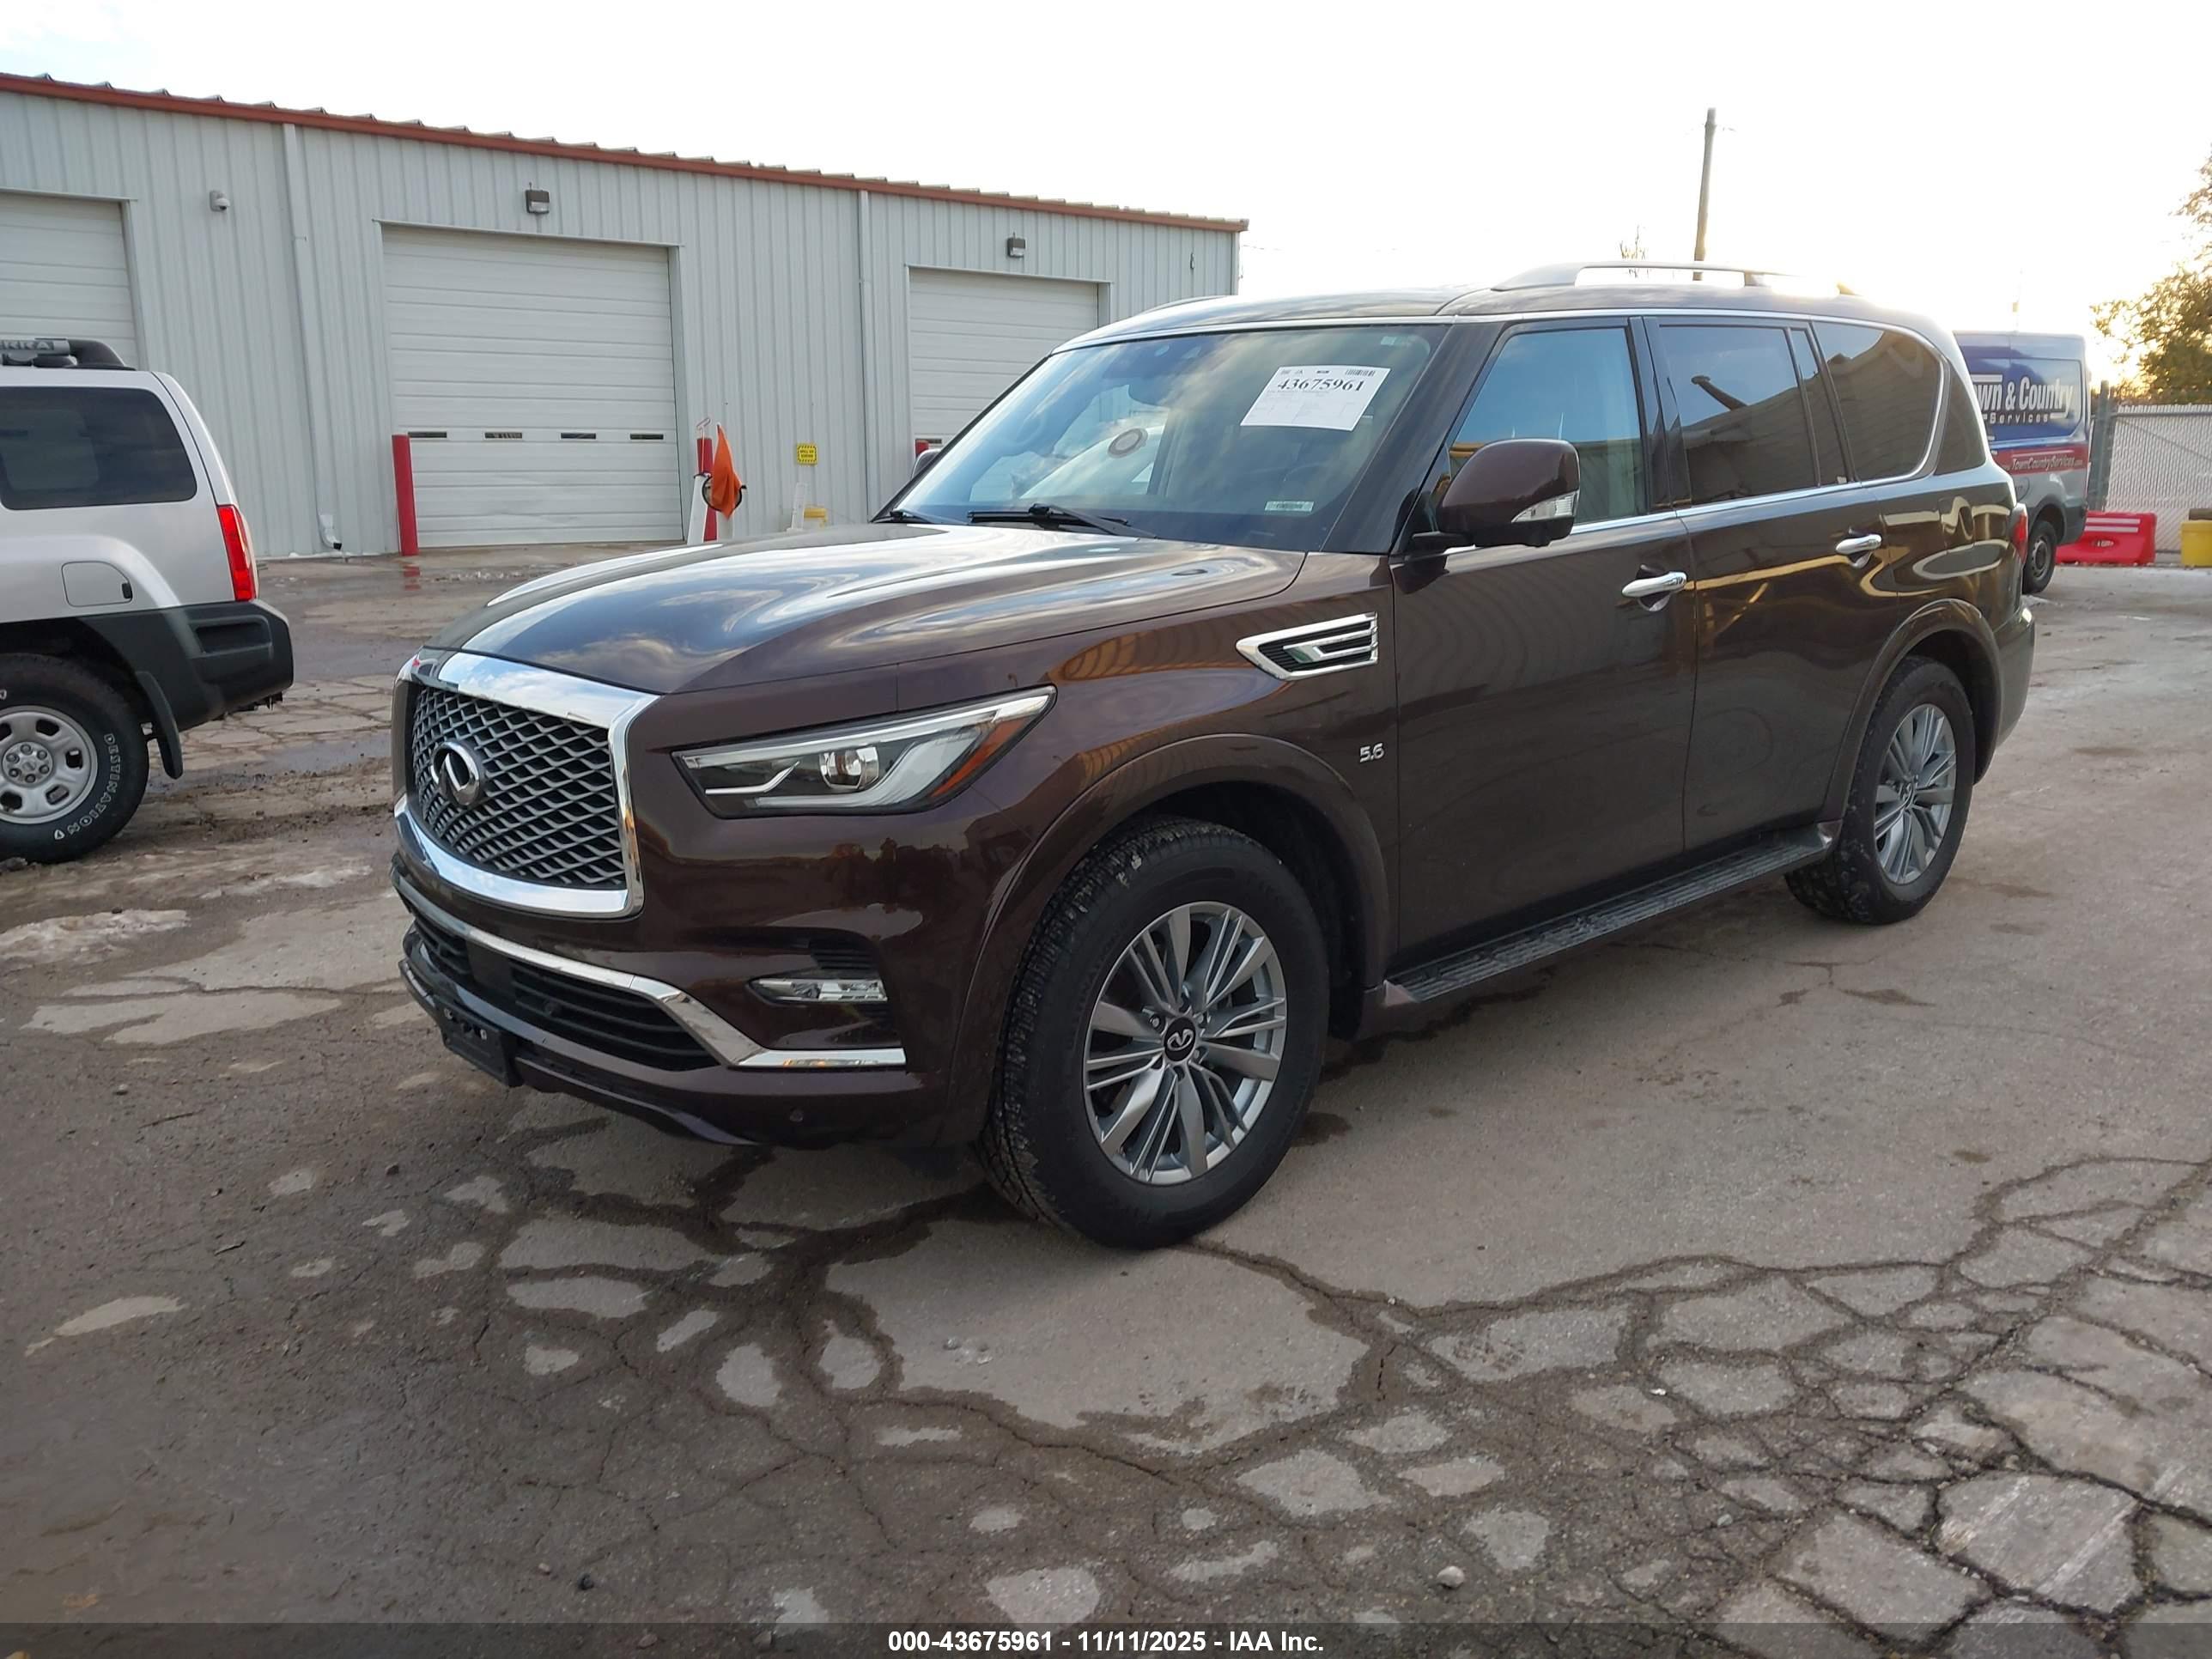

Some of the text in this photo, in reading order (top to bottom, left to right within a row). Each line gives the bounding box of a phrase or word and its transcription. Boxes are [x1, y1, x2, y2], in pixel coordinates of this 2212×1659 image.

[0, 340, 52, 350] RRA
[1278, 378, 1365, 392] 43675961
[1972, 376, 2074, 419] wn & Country
[1990, 412, 2049, 424] Services
[1359, 743, 1385, 763] 5.6
[67, 732, 121, 836] DESTINATION
